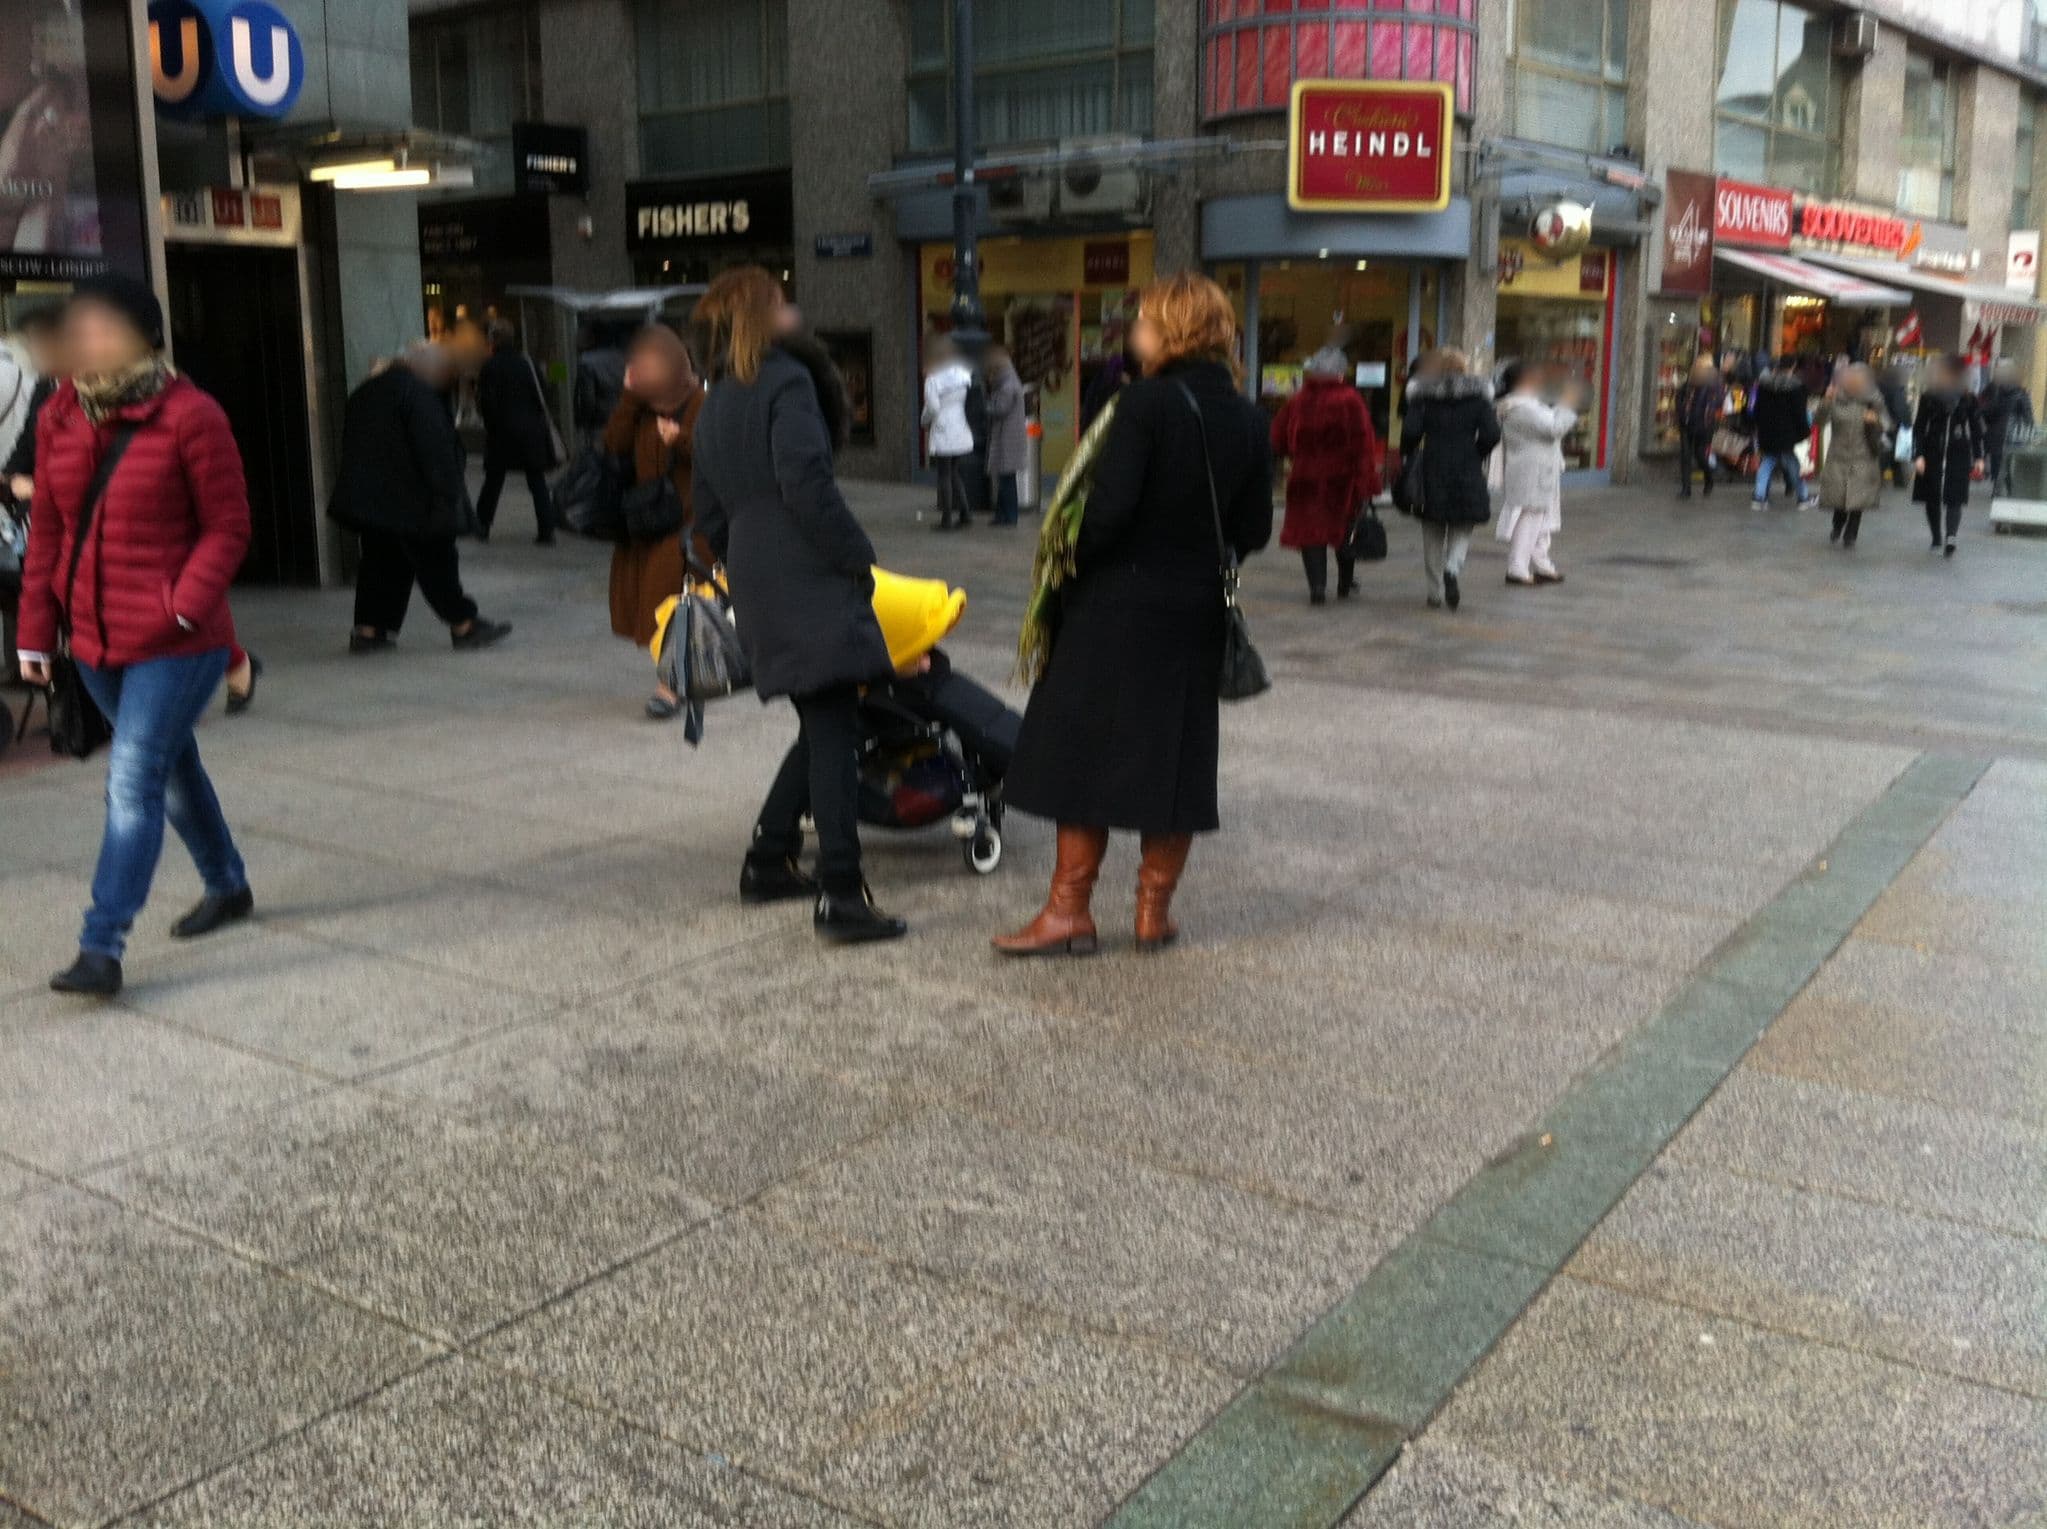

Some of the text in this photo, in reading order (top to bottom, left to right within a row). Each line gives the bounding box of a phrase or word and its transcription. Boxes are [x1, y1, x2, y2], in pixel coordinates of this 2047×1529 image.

[148, 16, 200, 103] U
[232, 16, 290, 106] U
[1309, 130, 1431, 158] HEINDL
[638, 201, 749, 238] FISHER'S
[1718, 190, 1789, 237] SOUVENIRS
